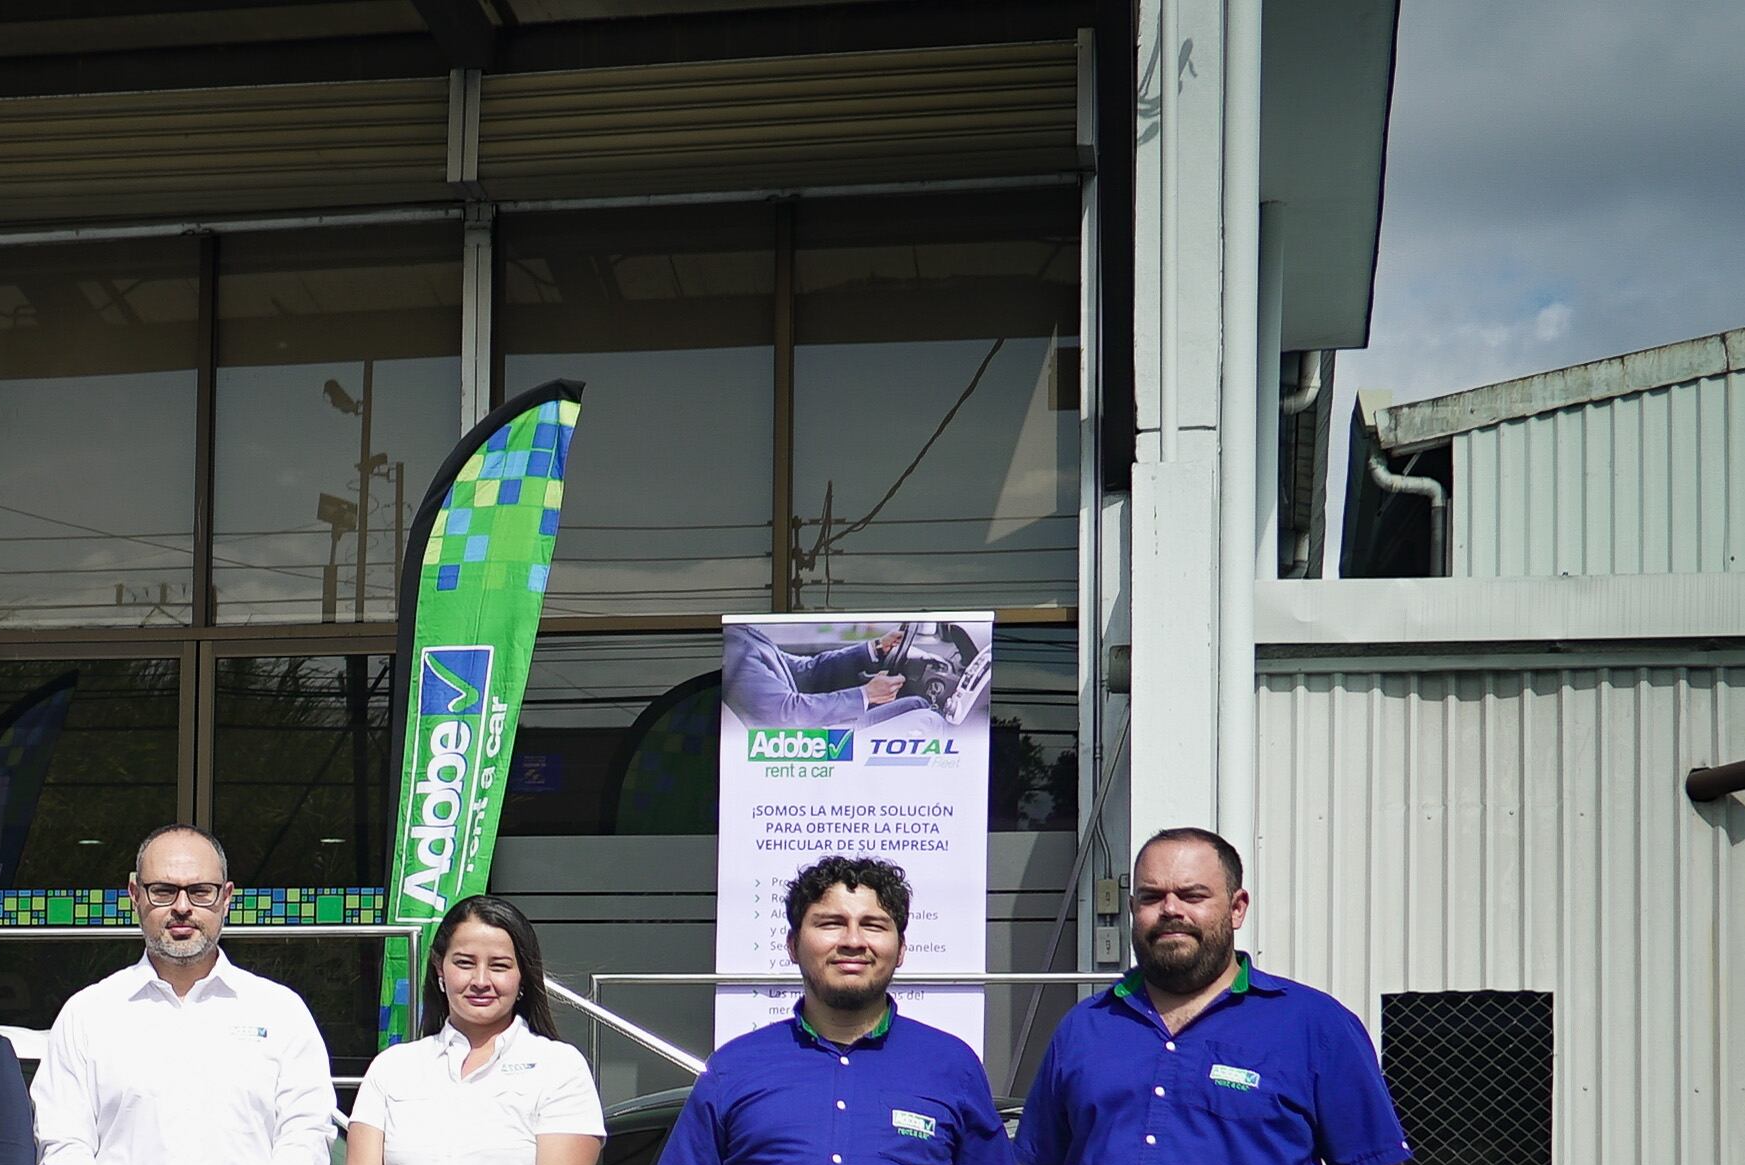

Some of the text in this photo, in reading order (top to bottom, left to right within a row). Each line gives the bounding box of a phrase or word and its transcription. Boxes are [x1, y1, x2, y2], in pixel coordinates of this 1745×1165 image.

[486, 696, 507, 758] car
[750, 730, 960, 759] Adobe TOTAL
[765, 764, 835, 778] rent a car
[403, 720, 471, 912] Adobe
[752, 803, 954, 819] ¡SOMOS LA MEJOR SOLUCIÓN
[766, 822, 940, 834] PARA OBTENER LA FLOTA
[756, 839, 949, 851] VEHICULAR DE SU EMPRESA!
